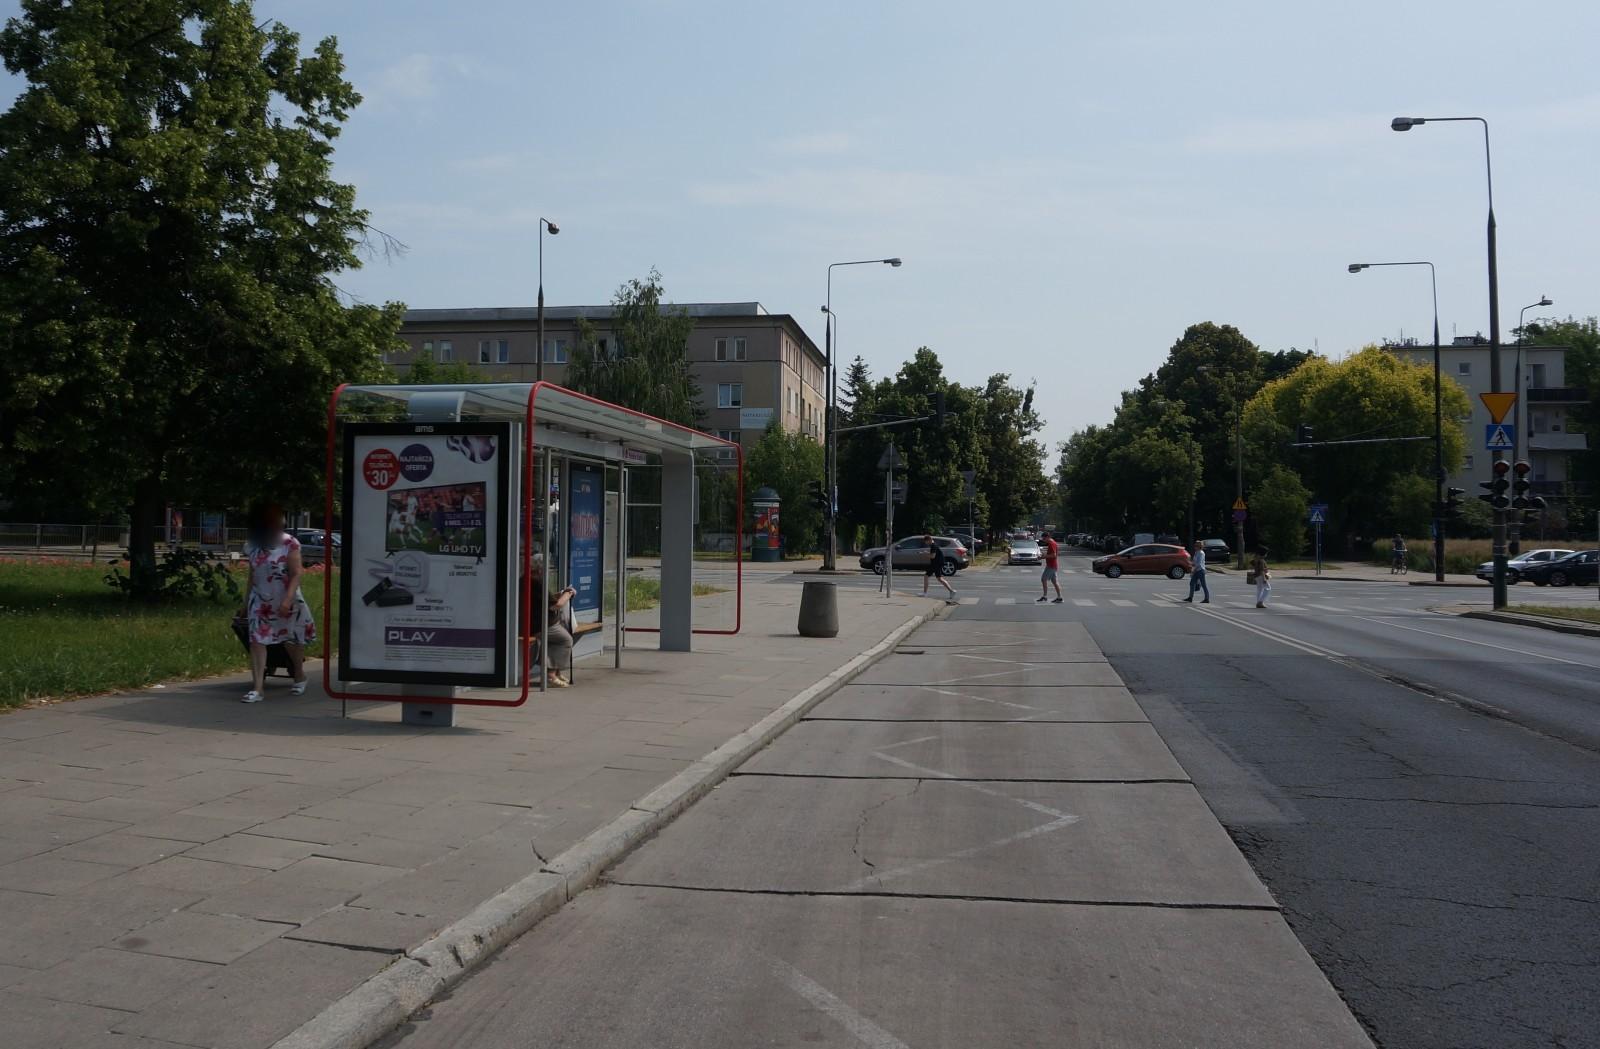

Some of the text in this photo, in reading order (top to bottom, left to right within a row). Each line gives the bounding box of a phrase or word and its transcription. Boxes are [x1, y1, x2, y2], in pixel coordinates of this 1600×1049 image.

[414, 425, 434, 433] ams
[371, 470, 389, 486] 30
[439, 545, 482, 554] LG UHD TV
[388, 630, 436, 643] PLAY
